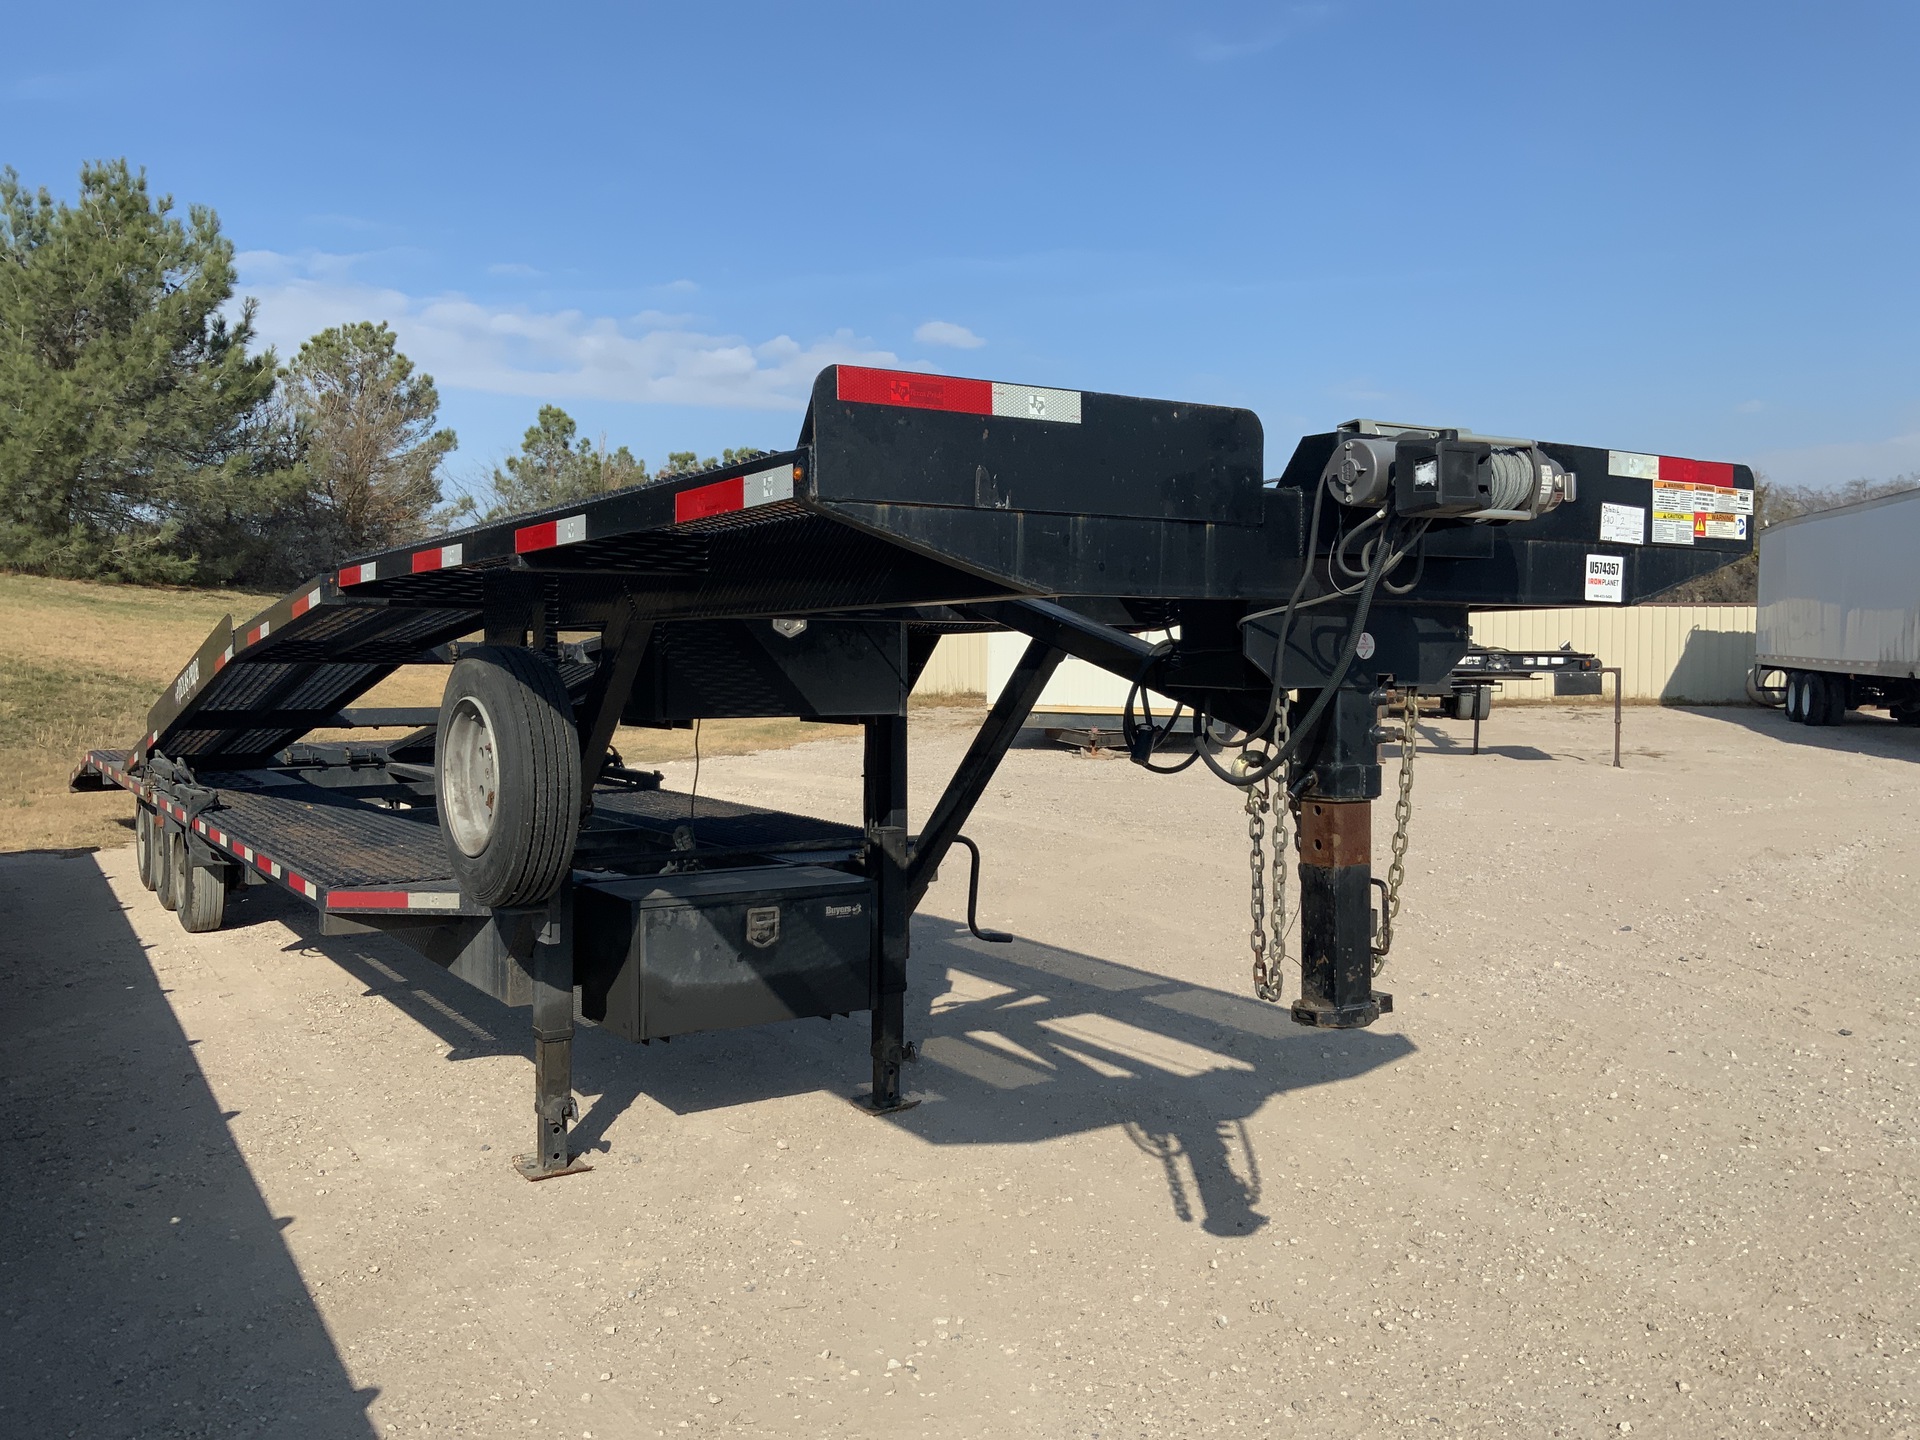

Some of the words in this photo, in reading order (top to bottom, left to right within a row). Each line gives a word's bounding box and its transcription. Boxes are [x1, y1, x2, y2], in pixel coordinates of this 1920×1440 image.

[1711, 514, 1734, 522] WARNING
[1589, 561, 1620, 576] U574357
[825, 905, 852, 915] Buyers
